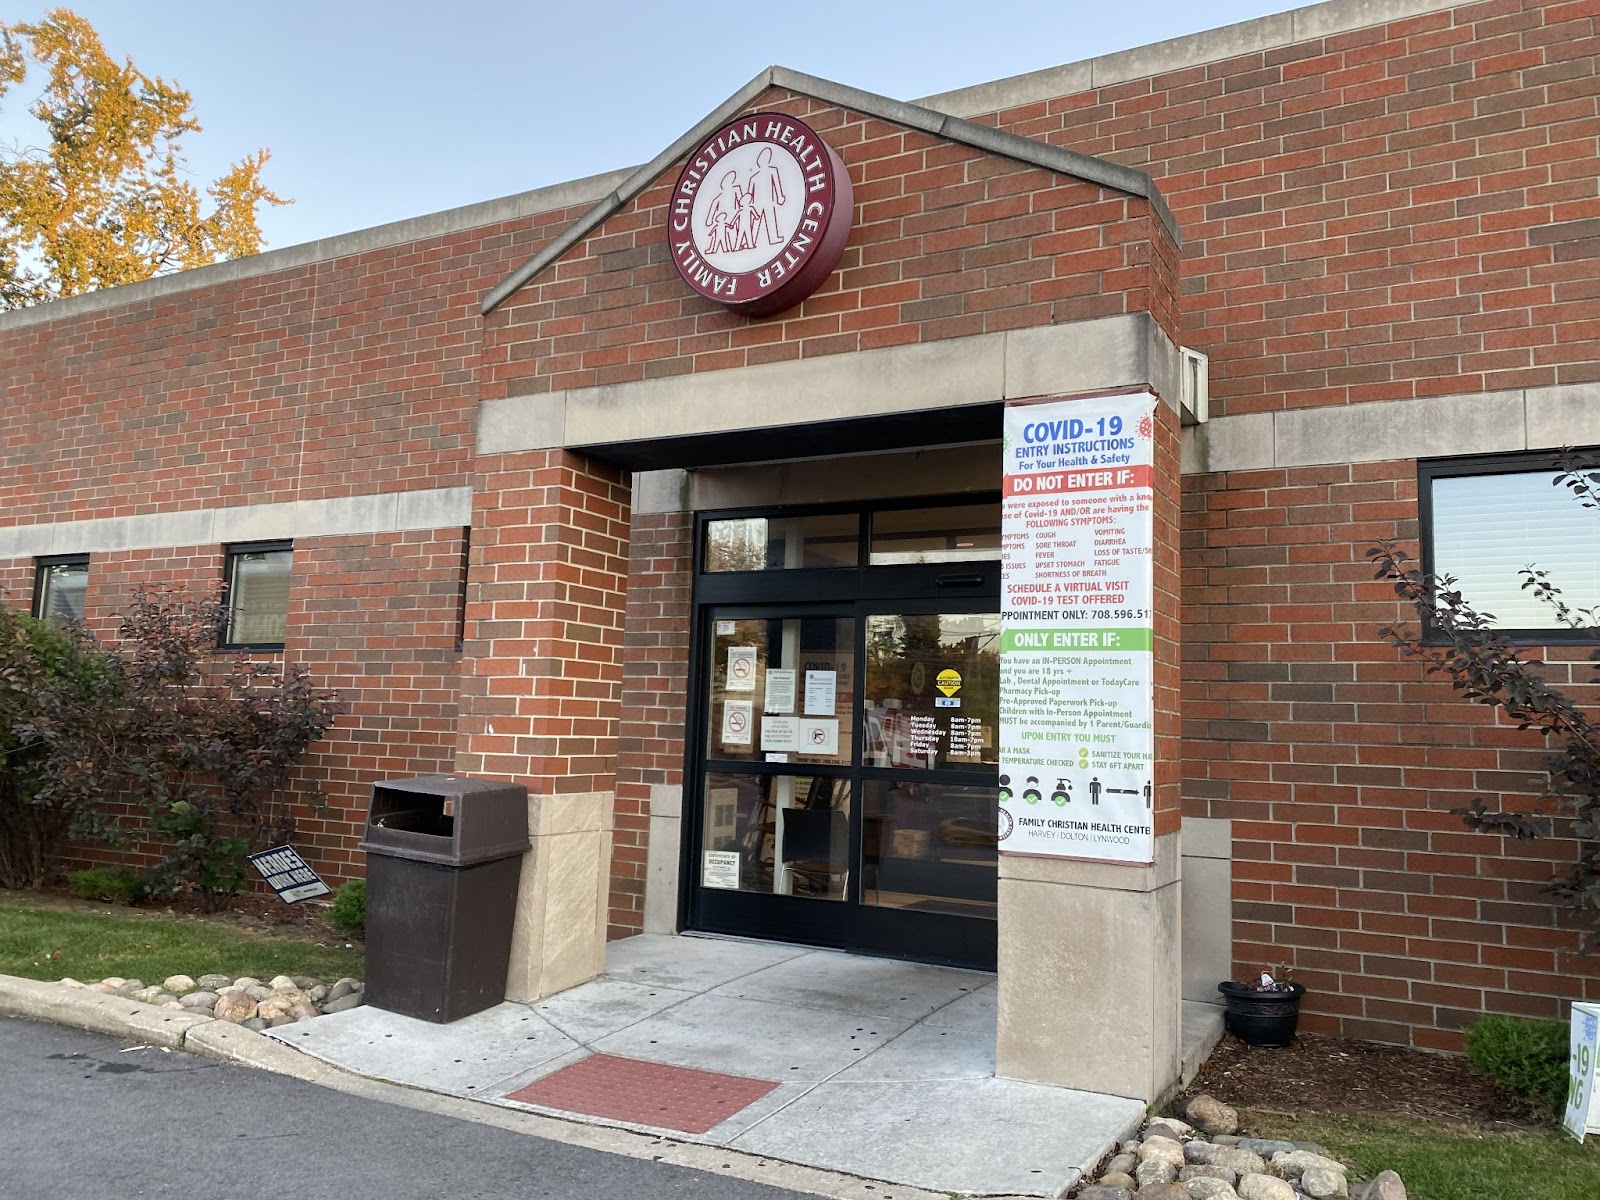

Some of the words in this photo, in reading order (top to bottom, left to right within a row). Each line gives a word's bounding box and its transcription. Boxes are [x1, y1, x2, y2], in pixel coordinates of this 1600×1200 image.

[765, 121, 826, 192] HEALTH
[674, 122, 758, 232] CHRISTIAN
[756, 201, 824, 288] CENTER
[676, 243, 737, 295] FAMILY
[1024, 416, 1122, 444] COVID-19
[1016, 445, 1049, 458] ENTRY
[1053, 438, 1135, 455] INSTRUCTIONS
[1019, 460, 1034, 470] For
[1036, 458, 1056, 469] Your
[1058, 455, 1088, 467] Health
[1091, 455, 1098, 464] &
[1101, 453, 1130, 466] Safety
[1014, 477, 1032, 492] DO
[1036, 475, 1063, 490] NOT
[1068, 472, 1112, 488] ENTER
[1117, 470, 1135, 484] IF:
[1028, 499, 1059, 509] exposed
[1072, 497, 1107, 505] someone
[1109, 494, 1126, 502] with
[1025, 509, 1058, 518] Covid-19
[1060, 506, 1090, 516] AND/OR
[1108, 505, 1134, 514] having
[1026, 519, 1068, 528] FOLLOWING
[1071, 516, 1116, 526] SYMPTOMS:
[1094, 538, 1126, 546] DIARRHEA
[1007, 584, 1052, 593] SCHEDULE
[1055, 583, 1061, 592] A
[1064, 582, 1102, 592] VIRTUAL
[1105, 581, 1129, 591] VISIT
[1012, 596, 1054, 605] COVID-19
[1057, 595, 1079, 604] TEST
[1082, 594, 1124, 604] OFFERED
[1062, 610, 1088, 620] ONLY:
[1091, 609, 1151, 619] 708.596.51
[1014, 633, 1049, 647] ONLY
[1054, 633, 1098, 647] ENTER
[1103, 633, 1120, 646] IF:
[1083, 657, 1132, 666] Appointment
[1042, 678, 1089, 686] Appointment
[1101, 678, 1139, 687] TodayCare
[1000, 687, 1032, 696] Pharmacy
[1034, 688, 1060, 697] Pick-up
[1000, 697, 1047, 706] Pre-Approved
[1049, 698, 1087, 707] Paperwork
[1090, 699, 1117, 708] Pick-up
[1047, 708, 1081, 716] In-Person
[1083, 709, 1132, 718] Appointment
[1030, 719, 1076, 727] accompanied
[1079, 720, 1087, 729] by
[1022, 732, 1043, 740] UPON
[1046, 733, 1071, 741] ENTRY
[1074, 734, 1090, 742] YOU
[1094, 735, 1116, 743] MUST
[1002, 757, 1044, 765] TEMPERATURE
[1019, 818, 1045, 828] FAMILY
[1048, 819, 1088, 830] CHRISTIAN
[1091, 823, 1122, 833] HEALTH
[1028, 830, 1057, 839] HARVEY
[1061, 832, 1088, 841] DOLTON
[1094, 835, 1129, 844] LYNWOOD
[252, 850, 304, 877] HEROES
